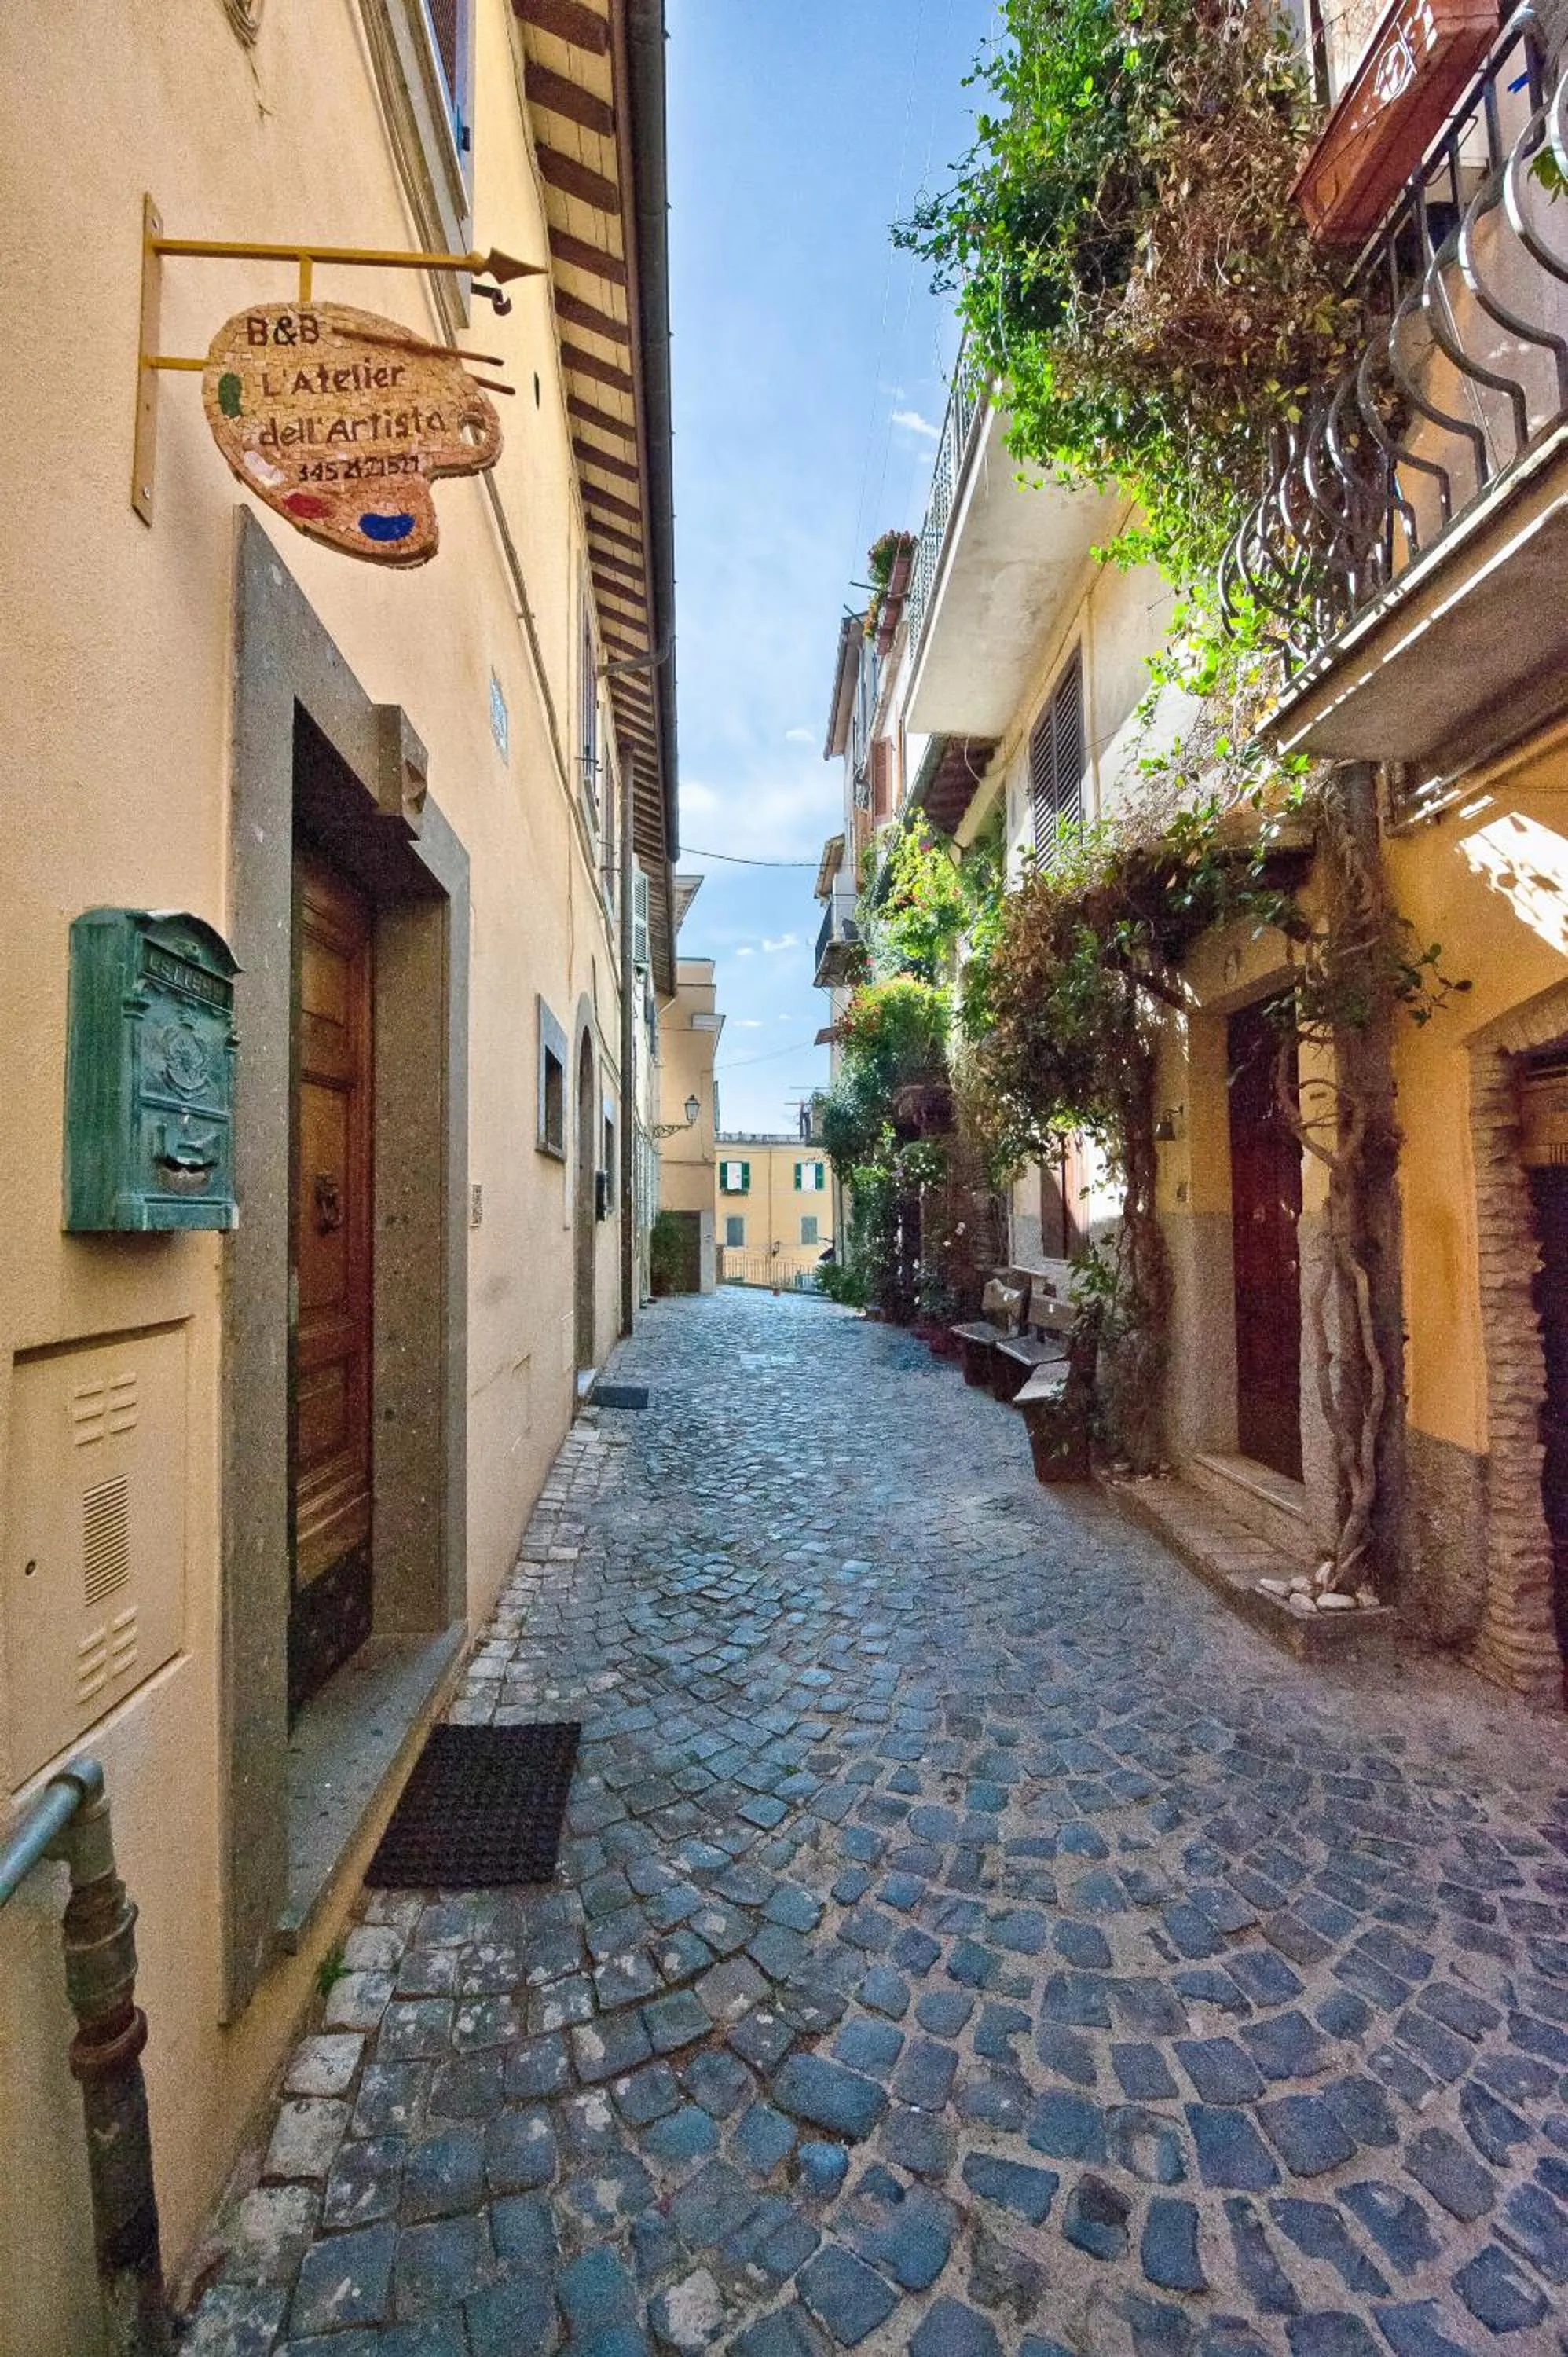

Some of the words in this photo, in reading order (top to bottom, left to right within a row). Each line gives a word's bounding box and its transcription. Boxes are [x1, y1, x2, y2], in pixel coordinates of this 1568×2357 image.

[247, 314, 320, 346] B&B
[262, 357, 405, 397] L'Atelier
[258, 405, 447, 451] dell'Artista
